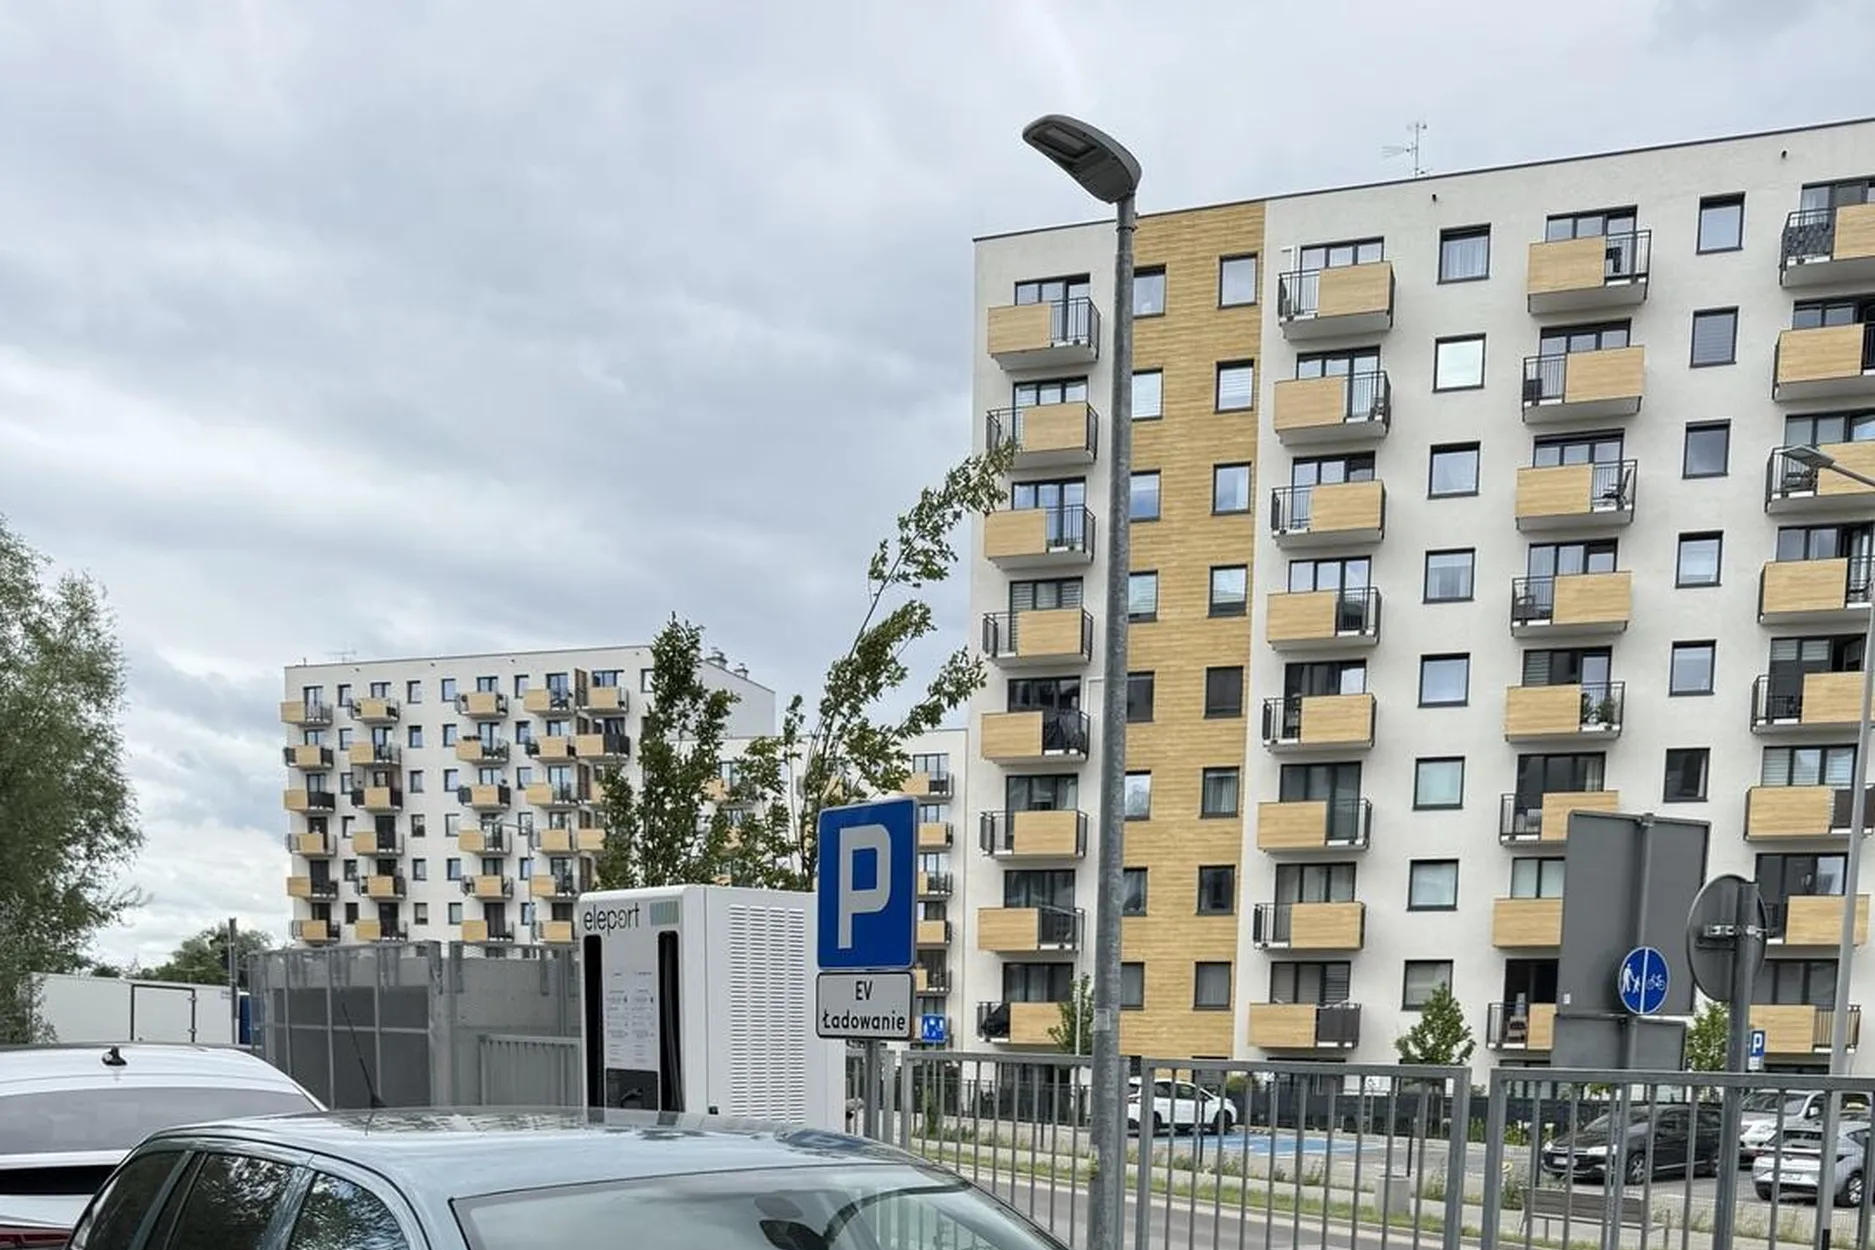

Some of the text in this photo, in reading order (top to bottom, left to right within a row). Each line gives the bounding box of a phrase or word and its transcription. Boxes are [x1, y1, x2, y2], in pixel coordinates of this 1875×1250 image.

[838, 823, 891, 949] P
[583, 902, 639, 936] eleport
[855, 980, 873, 1001] EV
[822, 1007, 906, 1031] Ładowanie
[1752, 1032, 1763, 1053] P
